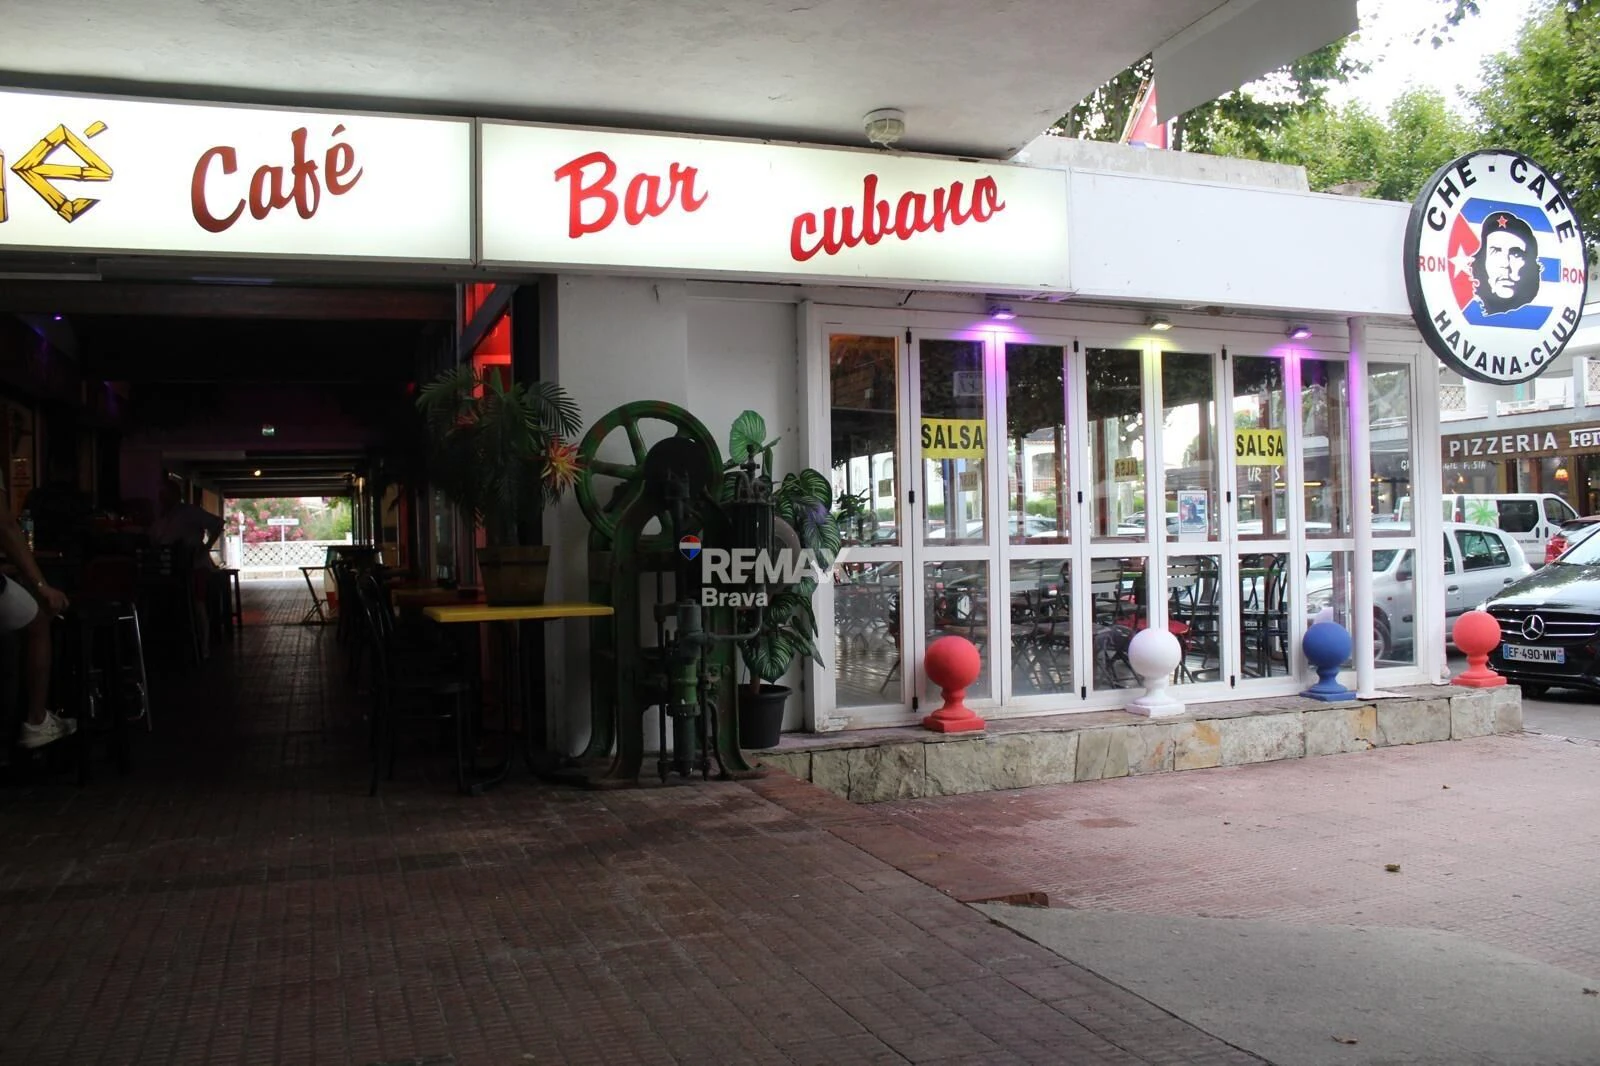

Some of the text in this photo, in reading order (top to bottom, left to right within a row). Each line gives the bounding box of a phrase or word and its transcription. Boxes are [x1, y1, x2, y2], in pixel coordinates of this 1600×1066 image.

[190, 124, 364, 233] Café
[554, 151, 1006, 262] Bar cubano
[1427, 158, 1477, 232] CHE
[1419, 256, 1446, 272] RON
[1562, 267, 1585, 284] RON
[921, 423, 985, 450] SALSA
[1235, 434, 1284, 457] SALSA
[1450, 431, 1558, 458] PIZZERIA
